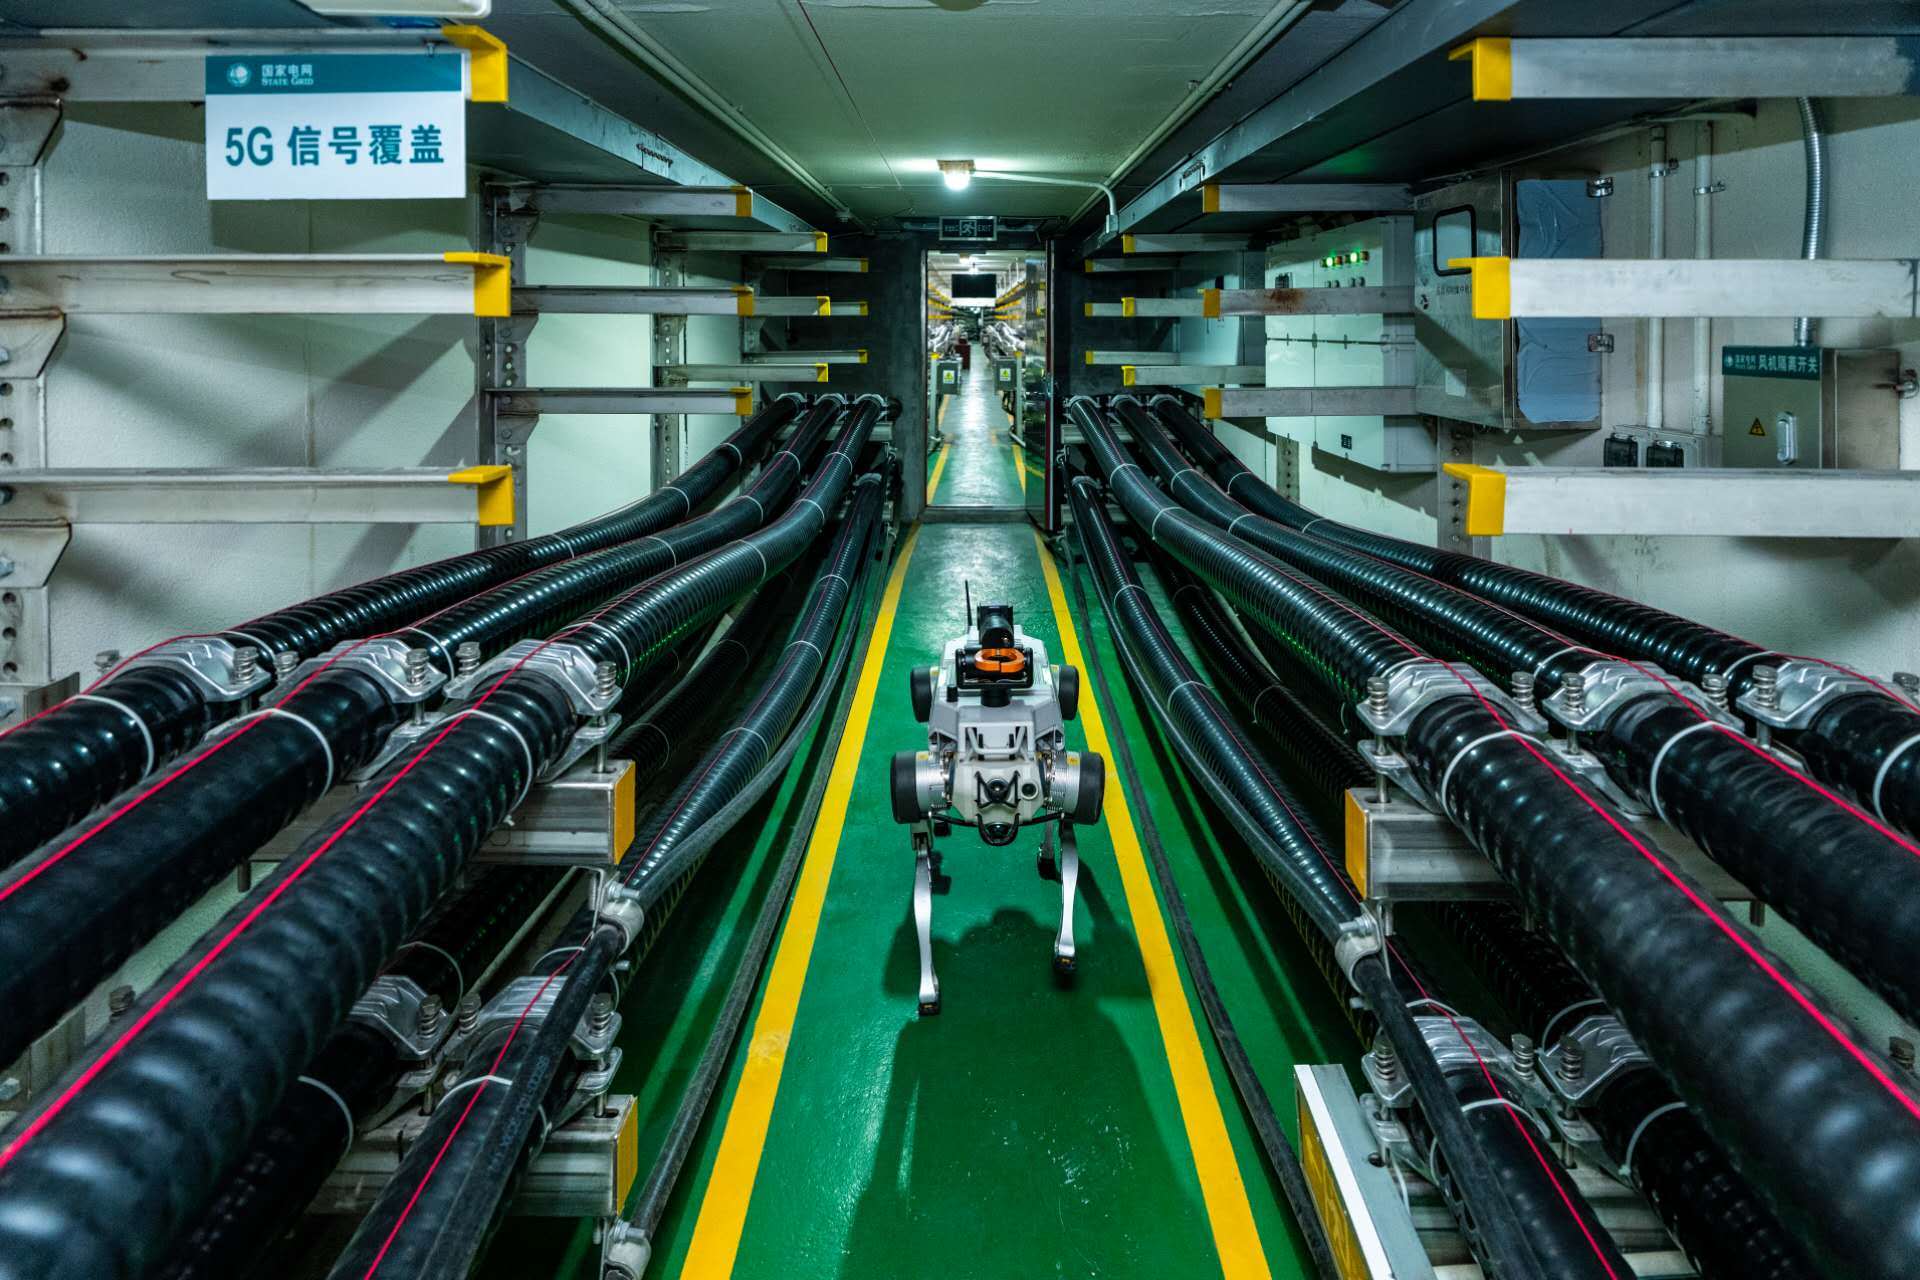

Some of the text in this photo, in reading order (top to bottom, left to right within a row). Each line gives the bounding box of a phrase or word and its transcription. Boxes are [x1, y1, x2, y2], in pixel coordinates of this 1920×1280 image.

[261, 64, 313, 78] 国家电网
[225, 124, 444, 167] 5G 信号覆盖
